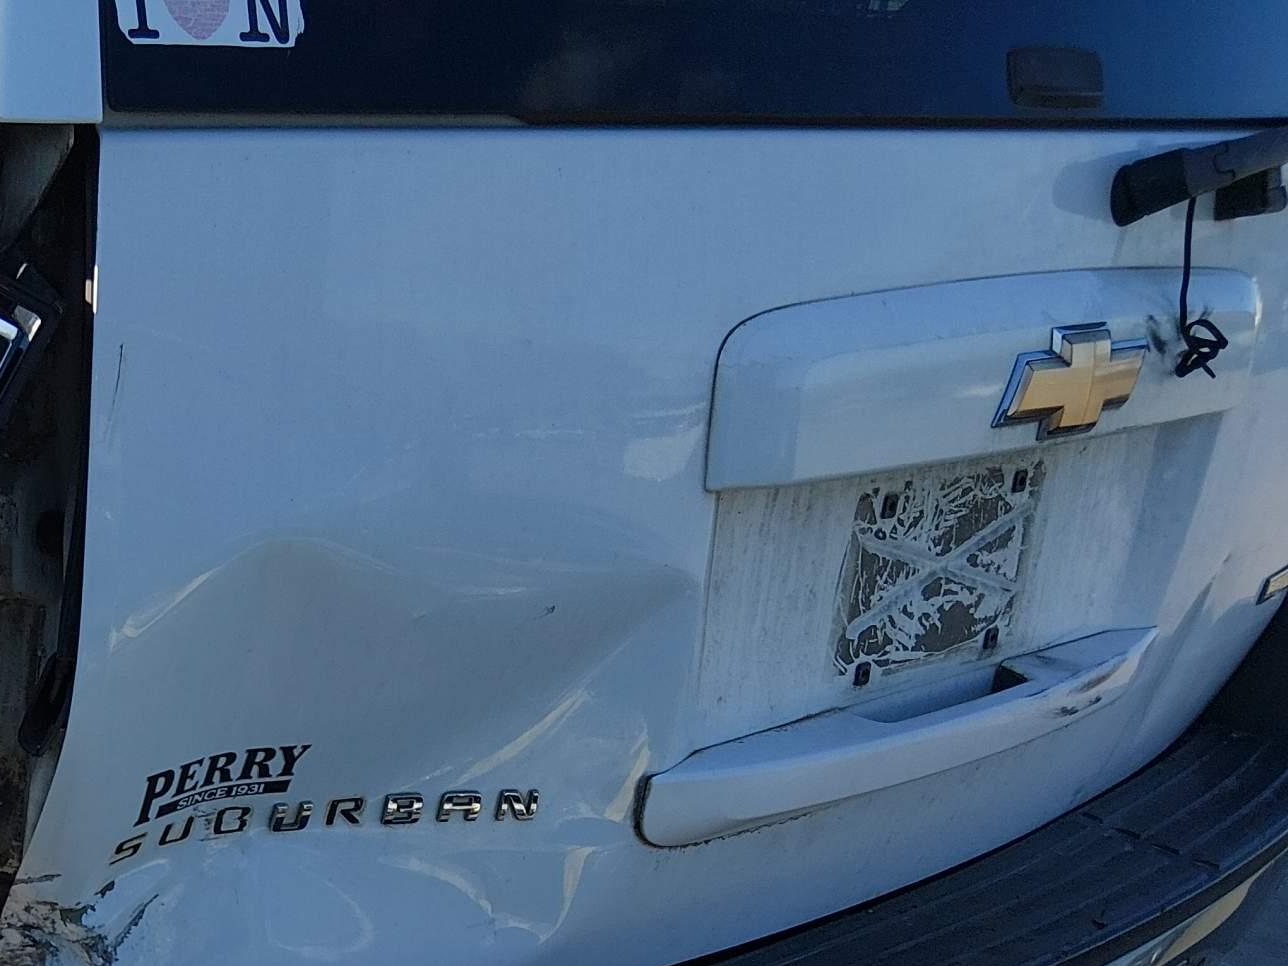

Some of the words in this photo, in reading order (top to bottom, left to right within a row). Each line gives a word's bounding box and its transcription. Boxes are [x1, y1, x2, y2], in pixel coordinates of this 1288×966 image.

[133, 743, 313, 828] PERRY
[177, 786, 228, 810] SINCE
[231, 783, 265, 798] 1931
[109, 787, 540, 866] SUBURBAN
